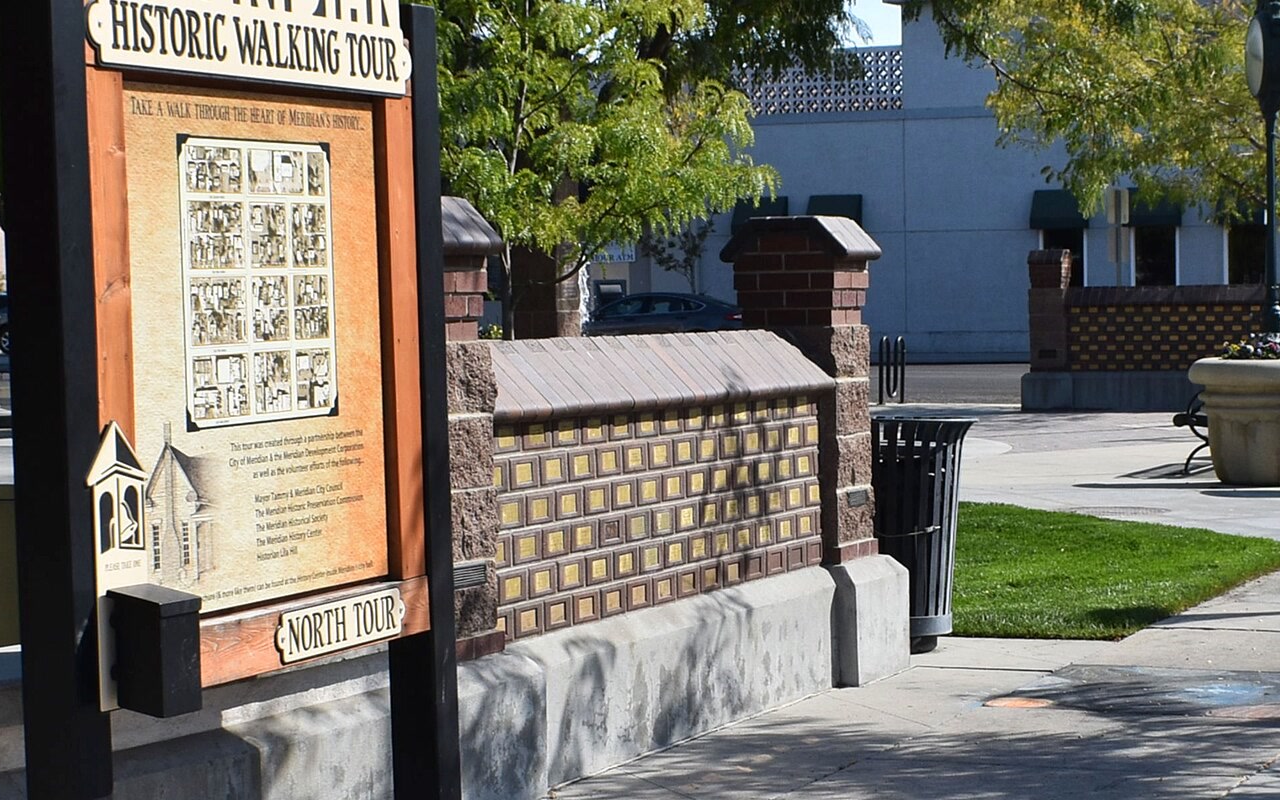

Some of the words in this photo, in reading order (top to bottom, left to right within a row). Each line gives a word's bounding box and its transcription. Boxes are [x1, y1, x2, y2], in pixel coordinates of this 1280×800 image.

[109, 0, 227, 61] HISTORIC
[233, 16, 340, 75] WALKING
[346, 32, 399, 82] TOUR
[130, 95, 153, 116] TAKE
[157, 100, 163, 117] A
[166, 101, 191, 119] WALK
[195, 103, 230, 122] THROUGH
[233, 106, 248, 123] THE
[250, 107, 274, 125] HEART
[277, 110, 285, 125] OF
[617, 253, 634, 261] ATM
[231, 442, 241, 451] This
[242, 442, 253, 450] tour
[254, 441, 263, 449] was
[264, 438, 283, 448] created
[229, 457, 239, 471] City
[240, 456, 246, 466] of
[246, 454, 269, 465] Meridian
[283, 449, 305, 460] Meridian
[277, 466, 285, 475] the
[286, 463, 308, 474] volunteer
[295, 486, 316, 497] Meridian
[316, 484, 325, 495] City
[326, 481, 343, 493] Council
[255, 508, 265, 518] The
[266, 505, 287, 516] Meridian
[256, 523, 265, 533] The
[266, 519, 288, 531] Meridian
[256, 538, 266, 547] The
[267, 533, 288, 545] Meridian
[288, 606, 347, 655] NORTH
[353, 595, 396, 638] TOUR
